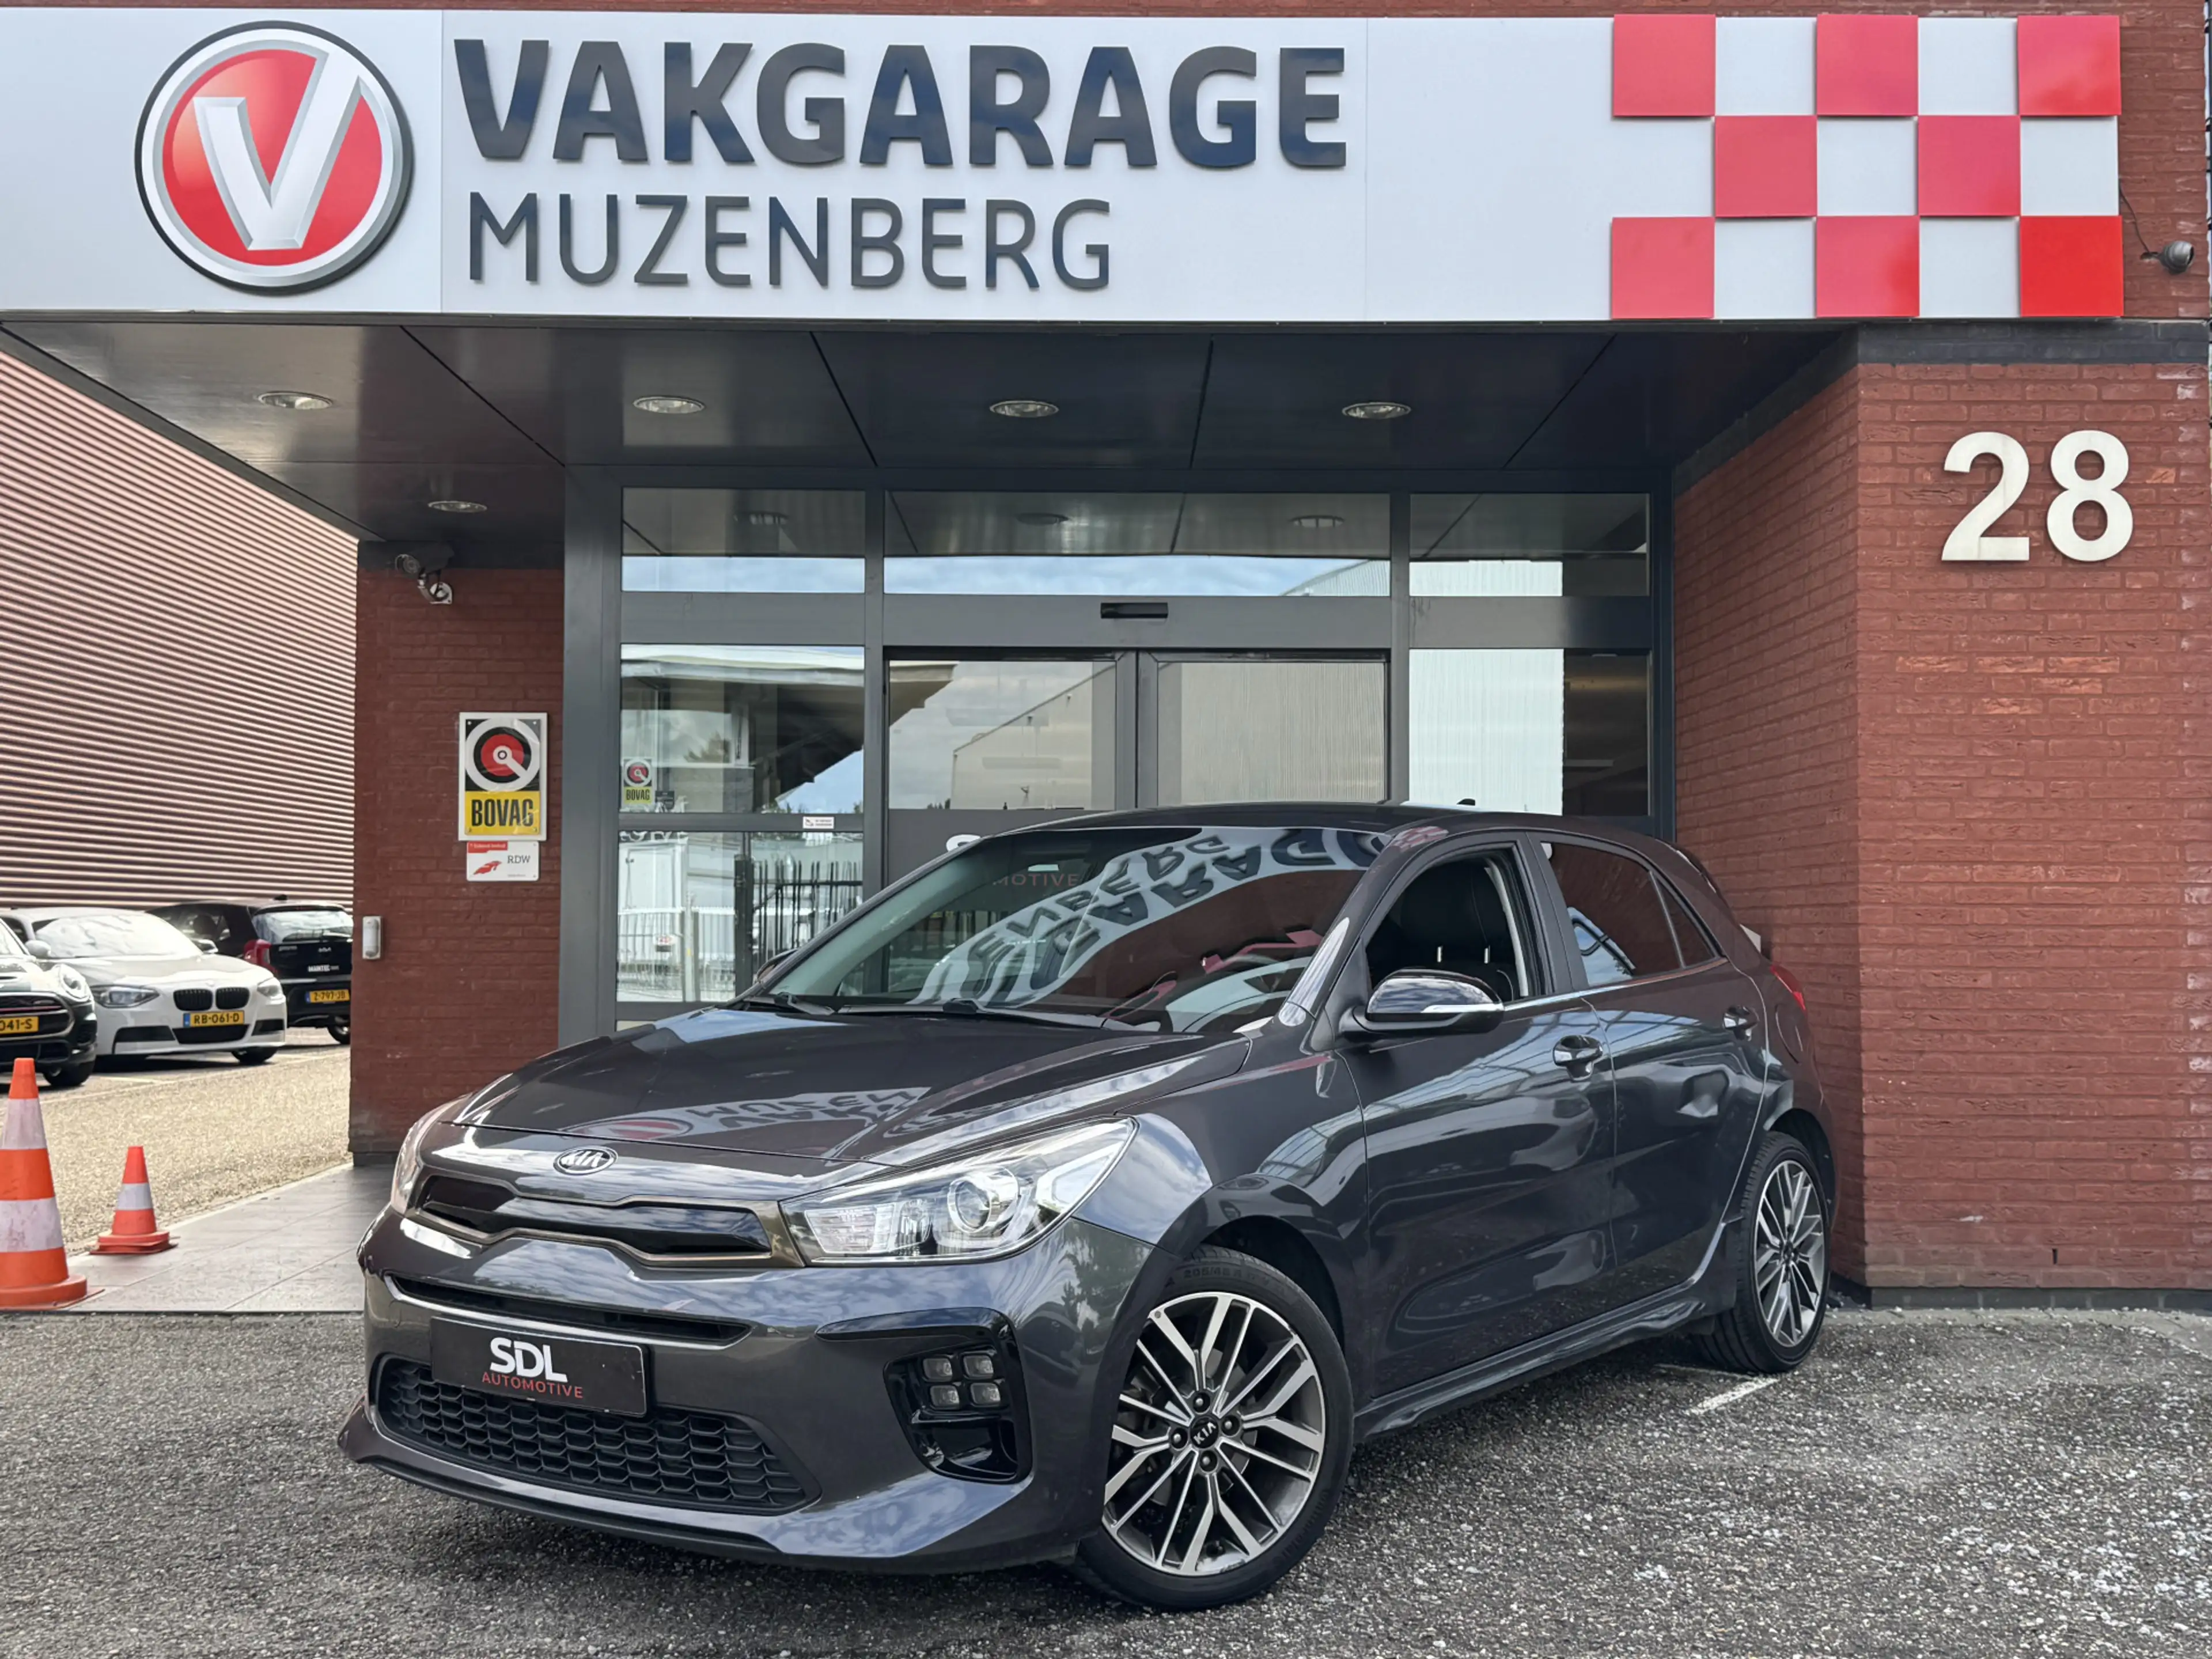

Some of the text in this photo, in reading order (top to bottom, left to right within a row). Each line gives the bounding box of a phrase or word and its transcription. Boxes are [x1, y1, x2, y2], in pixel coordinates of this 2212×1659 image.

[453, 38, 1347, 168] VAKGARAGE
[194, 50, 363, 251] V
[469, 191, 1111, 290] MUZENBERG
[1941, 429, 2134, 562] 28
[626, 789, 650, 801] BOVAG
[471, 798, 534, 827] BOVAG
[507, 854, 531, 864] RDW
[194, 1013, 240, 1024] RB-061-D
[490, 1336, 569, 1382] SDL
[482, 1371, 584, 1399] AUTOMOTIVE
[1193, 1422, 1217, 1445] KIA
